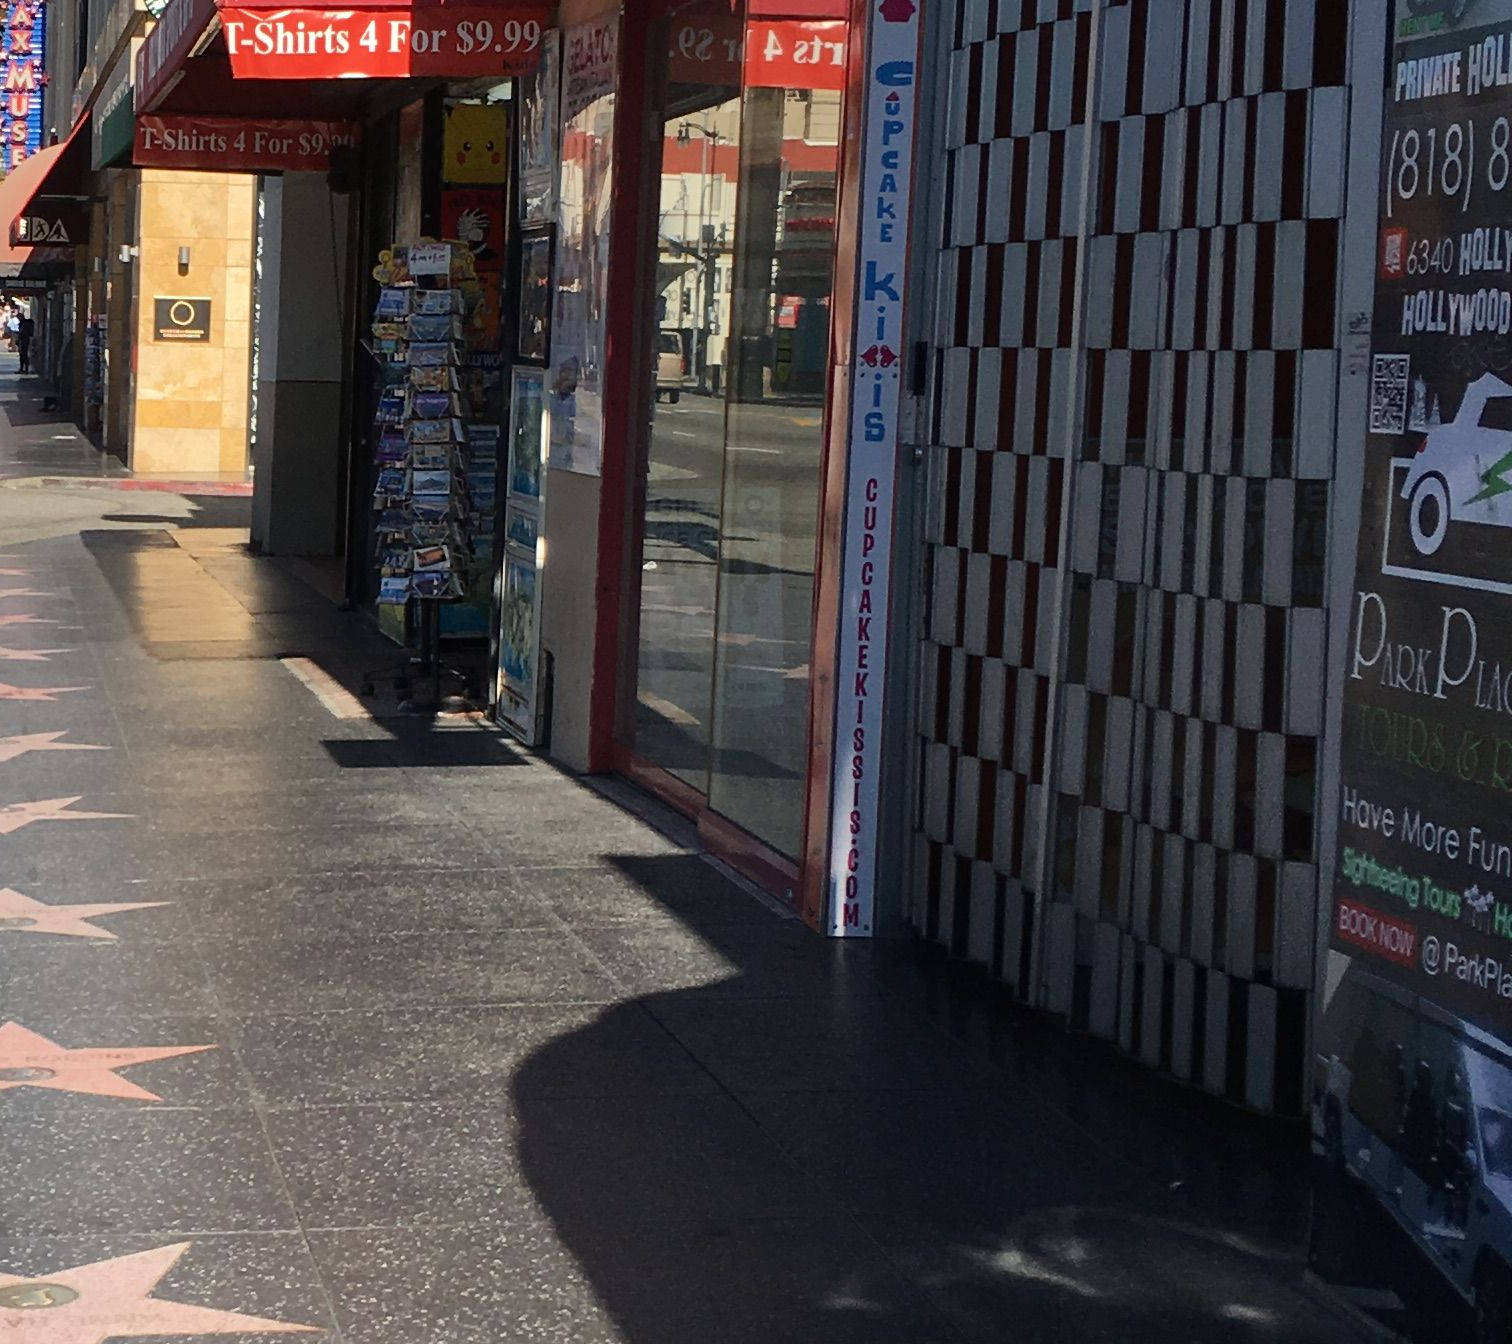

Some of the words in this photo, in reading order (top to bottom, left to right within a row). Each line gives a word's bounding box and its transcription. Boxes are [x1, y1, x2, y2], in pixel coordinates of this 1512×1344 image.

[226, 19, 350, 56] T-Shirts
[359, 20, 378, 53] 4
[388, 20, 447, 54] For
[456, 19, 541, 56] $9.99
[1394, 50, 1463, 102] PRIVATE
[4, 59, 37, 168] MUSE
[141, 127, 227, 153] T-Shirts
[234, 130, 246, 153] 4
[254, 131, 293, 154] For
[1386, 118, 1474, 218] (818)
[1406, 237, 1454, 276] 6340
[1401, 287, 1511, 336] HOLLYWOOD
[1350, 590, 1432, 696] PARK
[842, 477, 878, 928] CUPCAKEKISSIS.COM
[1342, 784, 1395, 838] Have
[1400, 808, 1460, 860] More
[1468, 830, 1511, 878] Fun
[1422, 875, 1462, 921] Tours
[1338, 903, 1378, 944] BOOK
[1379, 922, 1415, 958] NOW
